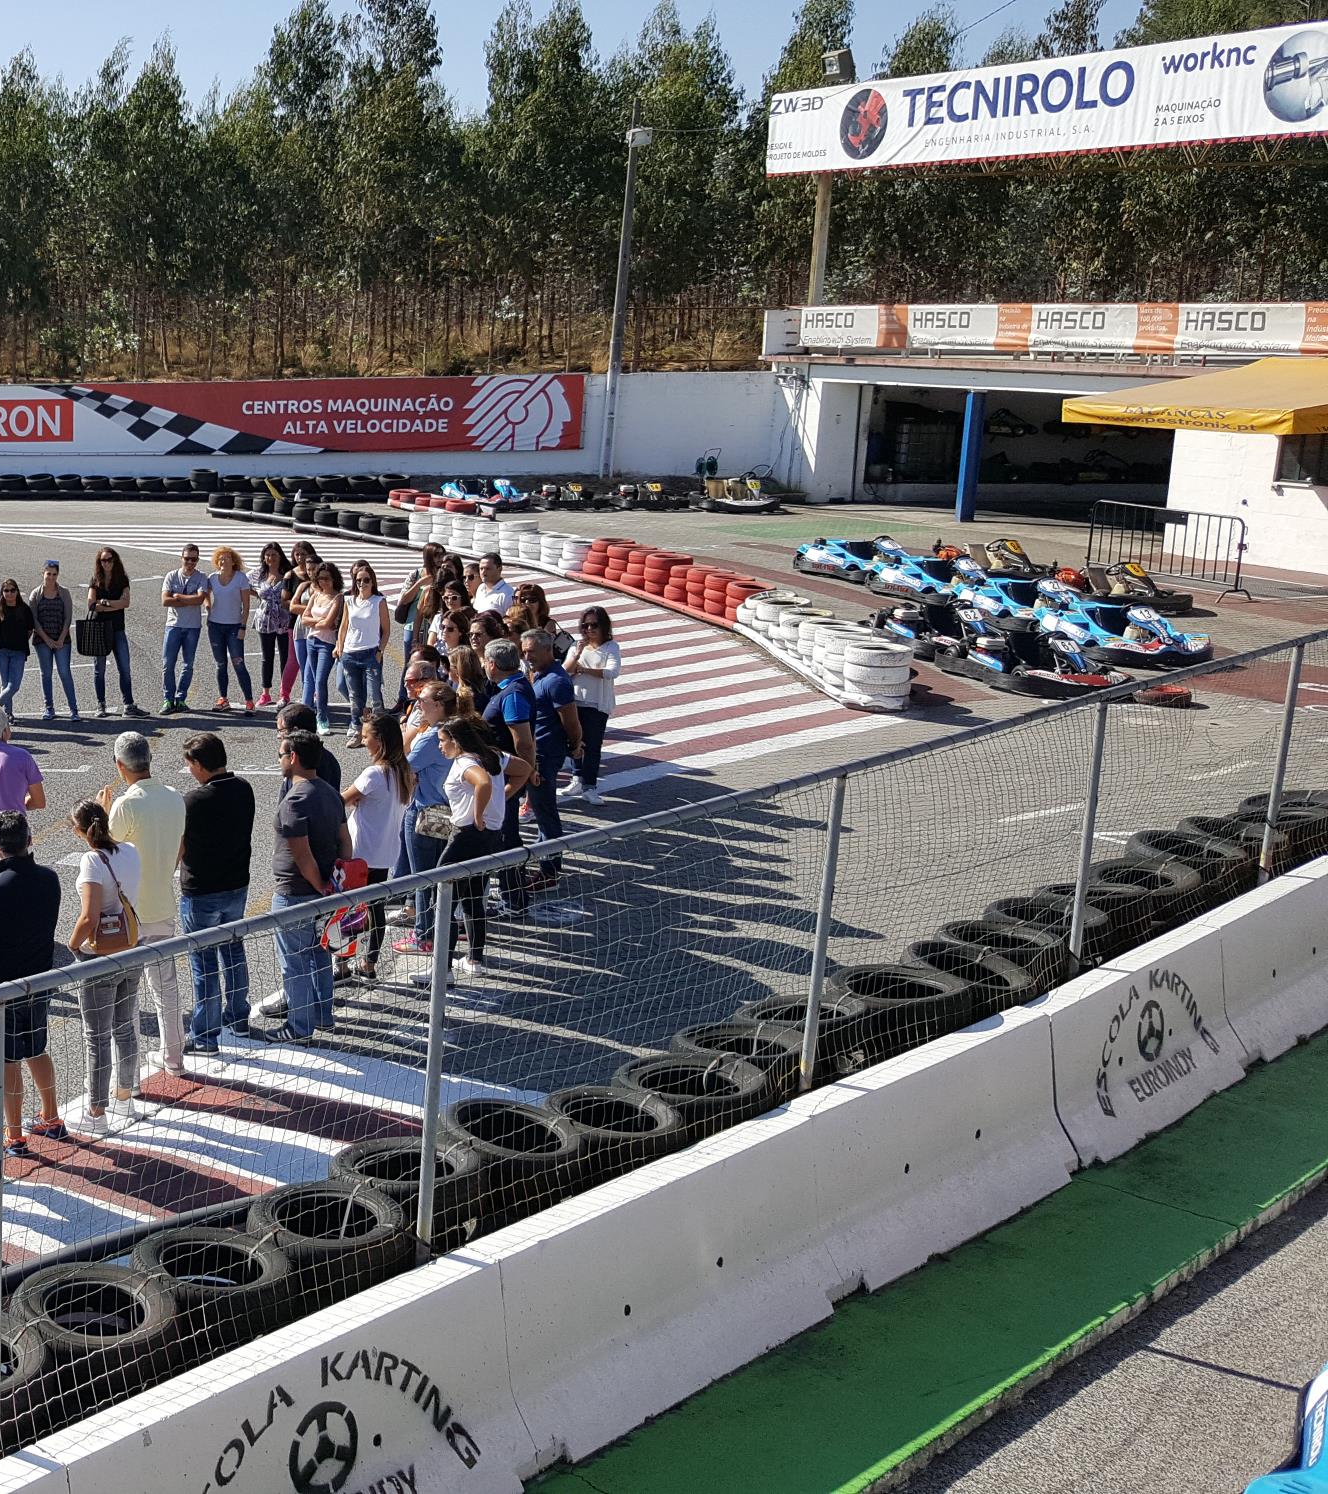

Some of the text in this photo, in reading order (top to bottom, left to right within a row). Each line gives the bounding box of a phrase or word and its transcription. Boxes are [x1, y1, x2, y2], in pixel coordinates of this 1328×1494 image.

[1161, 41, 1257, 75] worknc
[902, 60, 1135, 128] TECNIROLO
[1155, 97, 1222, 113] MAQUINAÇÃO
[1177, 114, 1205, 124] EIXOS
[924, 134, 991, 148] ENGENHARIA
[805, 312, 854, 329] HASCO
[913, 311, 971, 329] HASCO
[1037, 311, 1105, 330] HASCO
[1185, 311, 1266, 332] HASCO
[241, 393, 455, 416] CENTROS MAQUINAÇÃO
[283, 418, 449, 435] ALTA VELOCIDADE
[963, 610, 979, 620] 62
[1139, 609, 1152, 620] 13
[1060, 641, 1076, 652] 61
[1096, 968, 1221, 1118] ESCOLA KARTING
[1127, 1047, 1198, 1103] EUROINDY
[202, 1349, 482, 1494] OLA KARTING
